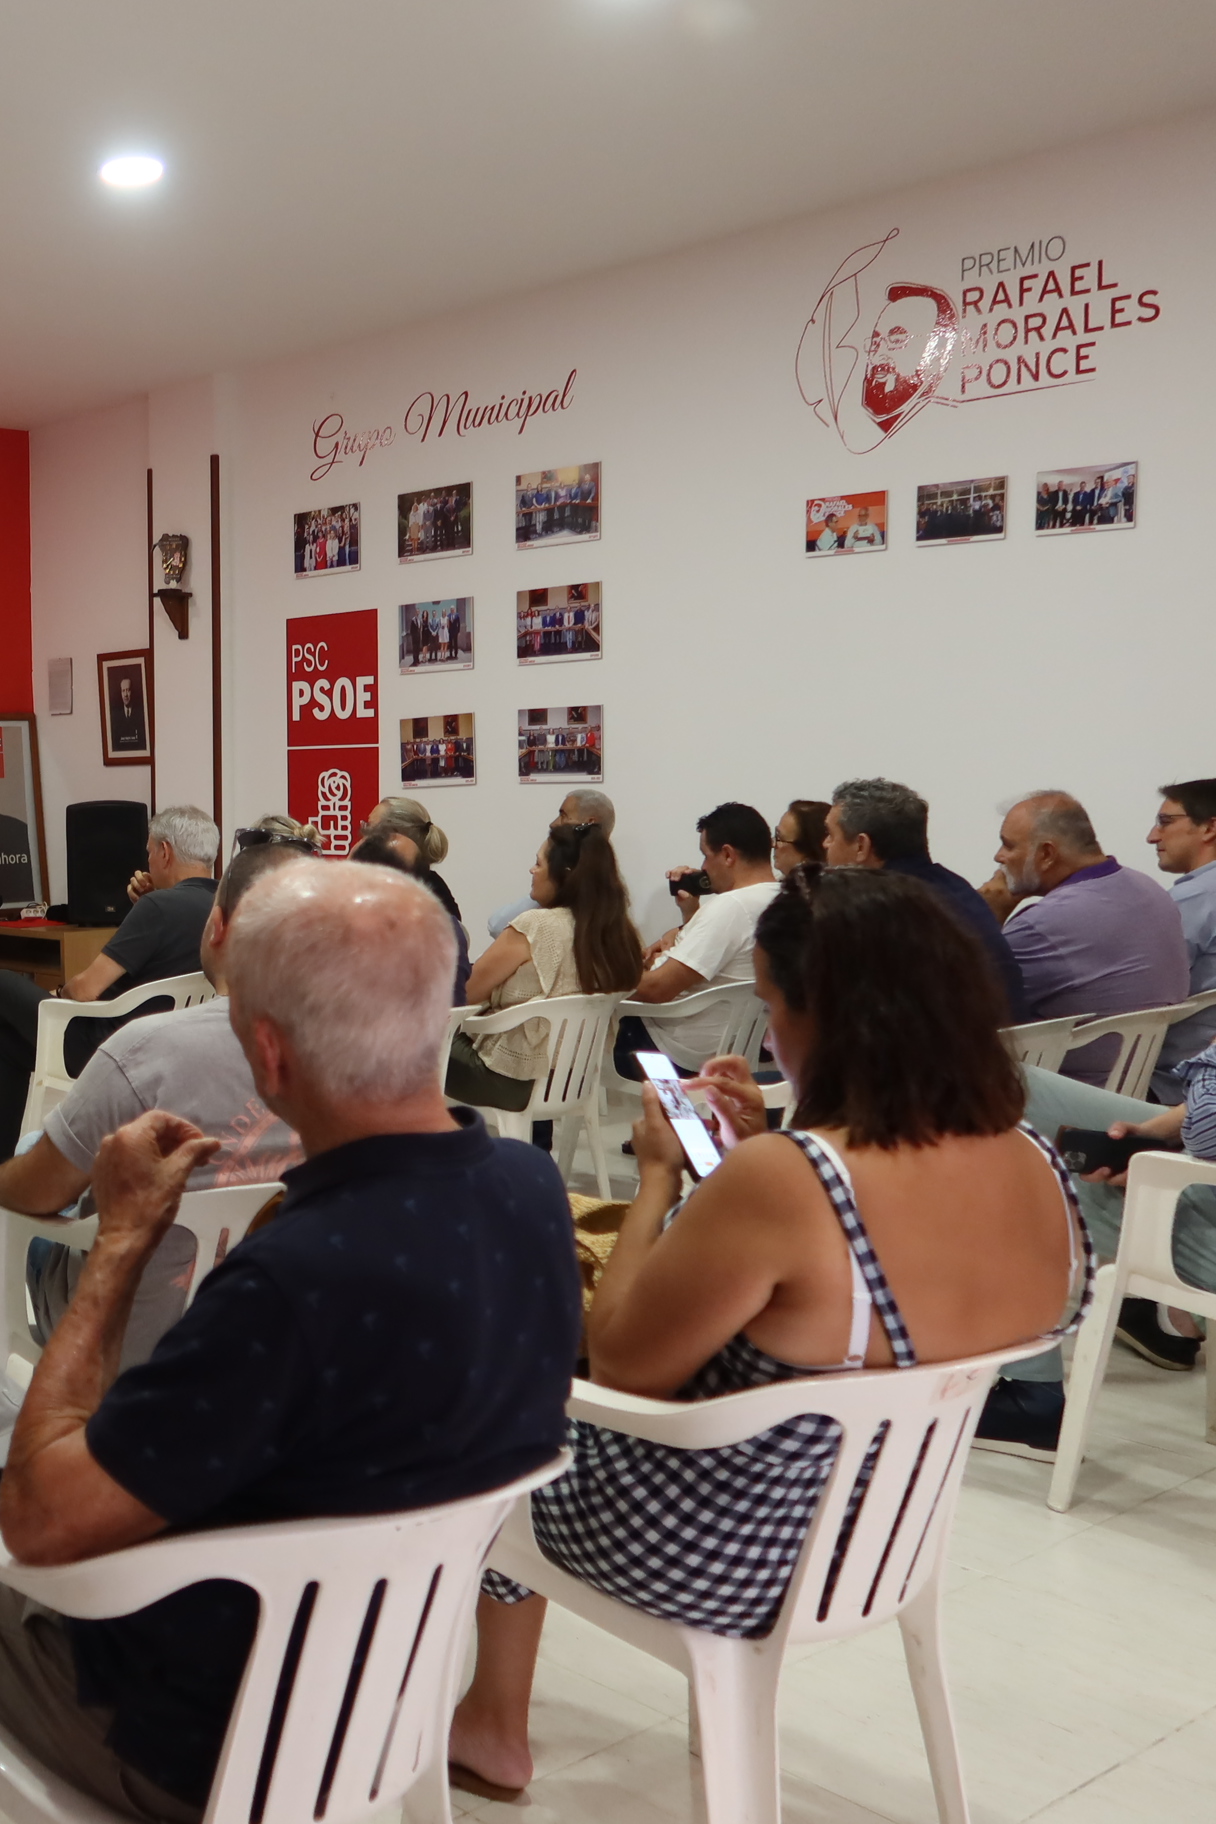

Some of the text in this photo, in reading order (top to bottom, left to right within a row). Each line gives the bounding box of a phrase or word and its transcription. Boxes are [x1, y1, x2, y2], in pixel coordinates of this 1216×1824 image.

[960, 235, 1067, 282] PREMIO
[960, 259, 1119, 319] RAFAEL
[960, 289, 1162, 358] MORALES
[960, 341, 1097, 396] PONCE
[310, 368, 578, 482] Grupo Municipal
[291, 641, 329, 673] PSC
[291, 675, 375, 721] PSOE
